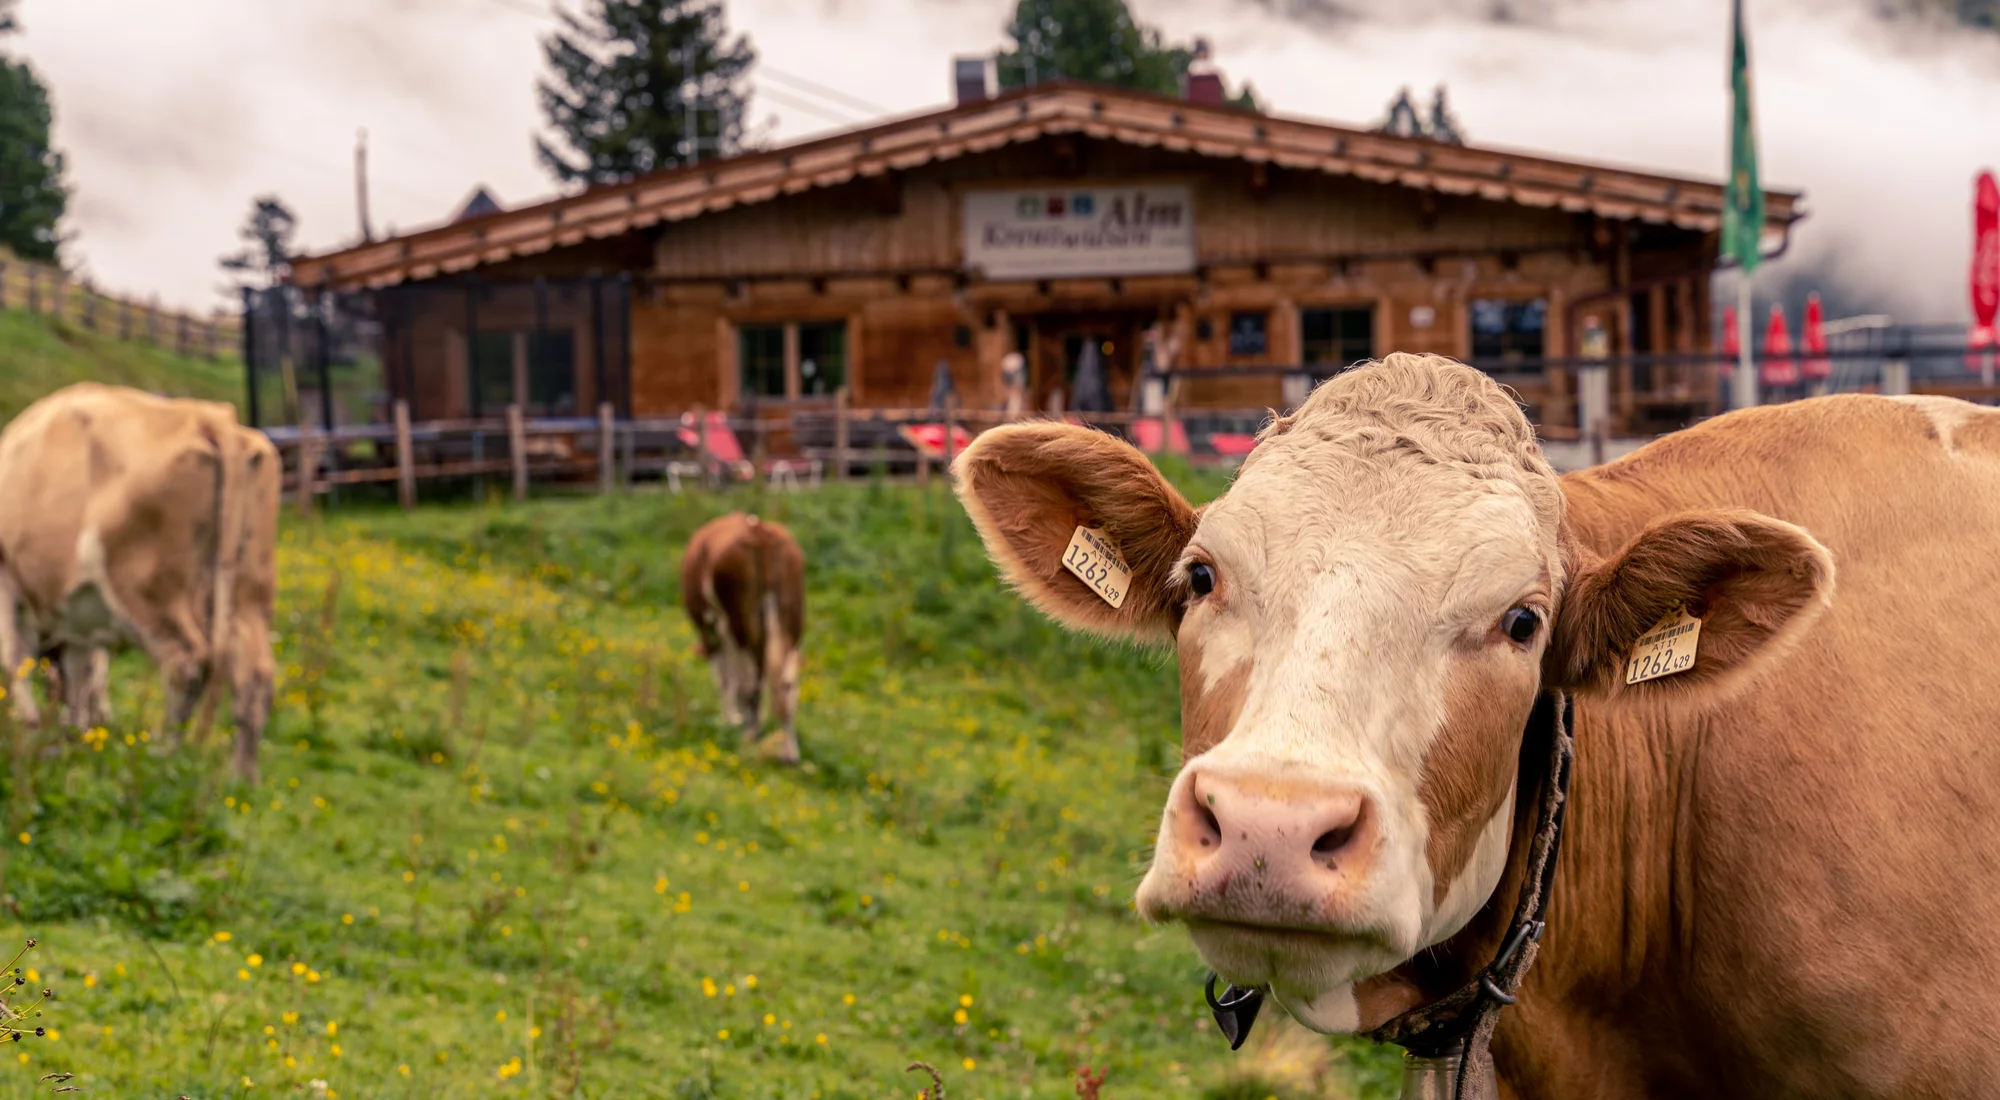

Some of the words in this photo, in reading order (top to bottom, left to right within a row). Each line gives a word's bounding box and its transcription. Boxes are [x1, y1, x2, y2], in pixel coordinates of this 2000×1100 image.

[1099, 191, 1183, 236] Alm
[1066, 544, 1108, 590] 1262
[1103, 583, 1120, 602] 429
[1629, 648, 1674, 683] 1262
[1673, 654, 1690, 670] 429
